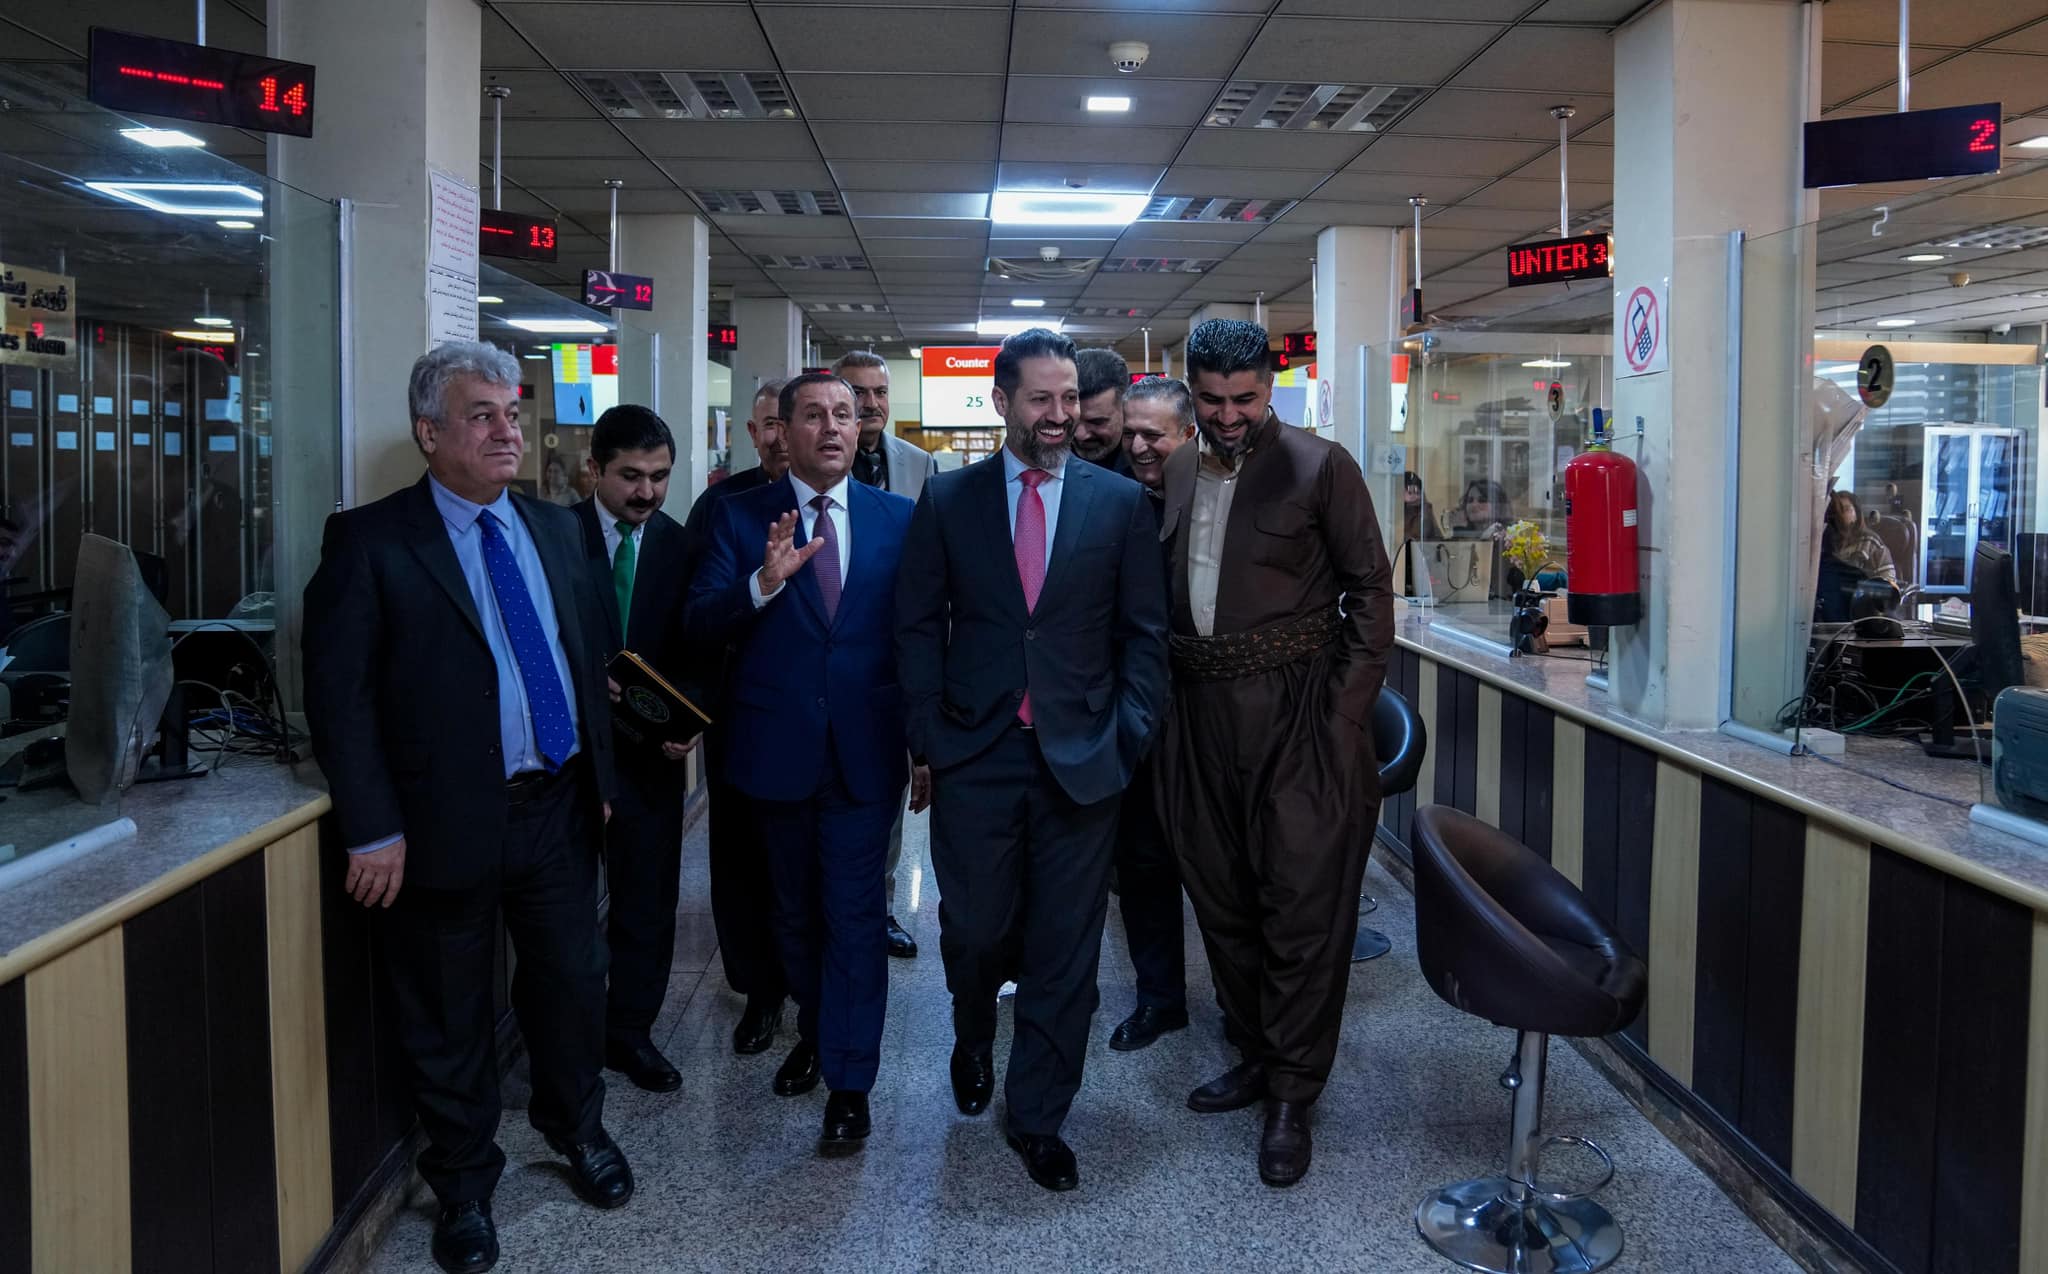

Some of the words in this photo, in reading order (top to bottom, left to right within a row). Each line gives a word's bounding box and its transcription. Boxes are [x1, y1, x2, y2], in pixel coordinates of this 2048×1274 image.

[260, 77, 307, 115] 14
[1969, 119, 1995, 152] 2
[529, 225, 555, 249] 13
[1509, 242, 1588, 276] UNTER
[1593, 243, 1607, 264] 3
[634, 284, 652, 303] 12
[720, 329, 736, 344] 11
[1303, 335, 1315, 351] 5
[945, 356, 990, 369] Counter
[1279, 353, 1289, 367] 6
[1867, 358, 1882, 392] 2
[966, 396, 984, 408] 25
[1552, 389, 1560, 412] 3
